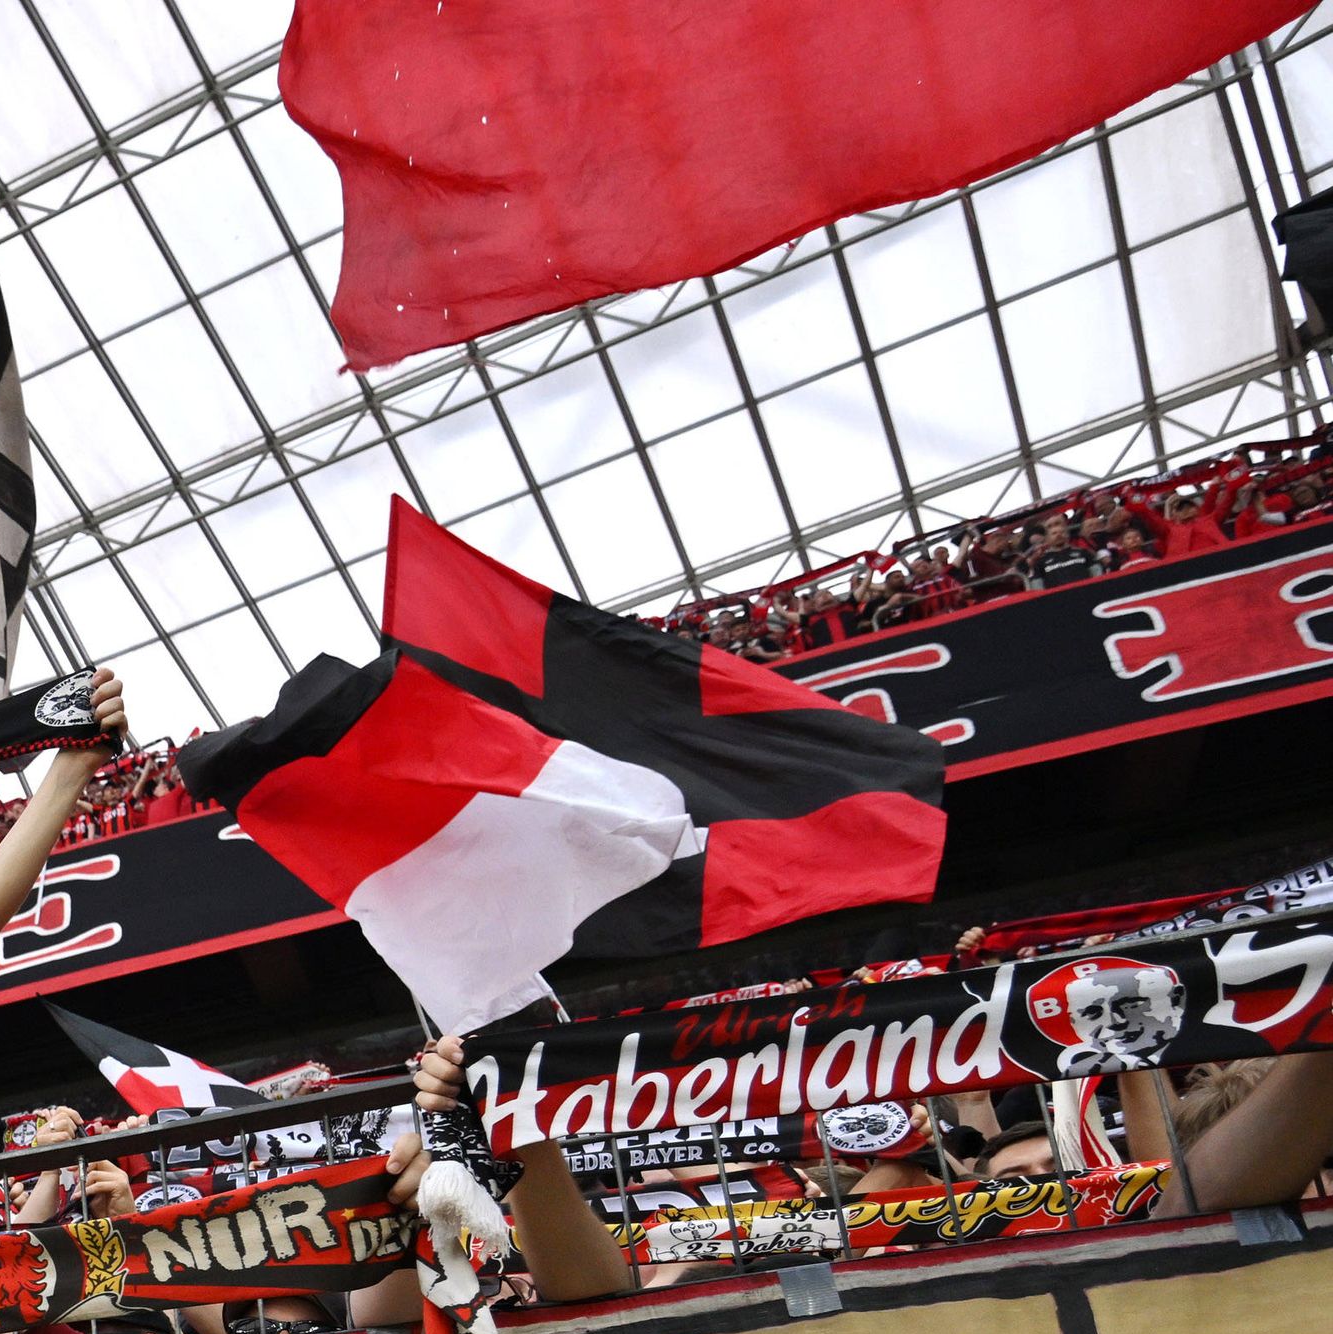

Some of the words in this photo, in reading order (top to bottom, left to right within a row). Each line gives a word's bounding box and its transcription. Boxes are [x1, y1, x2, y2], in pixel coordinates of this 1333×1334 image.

[671, 989, 867, 1062] Ulrich
[465, 962, 1023, 1150] Haberland
[629, 1145, 703, 1168] BAYER
[743, 1141, 781, 1156] CO.
[141, 1183, 337, 1282] NUR
[686, 1241, 721, 1255] 25
[781, 1222, 813, 1234] 04
